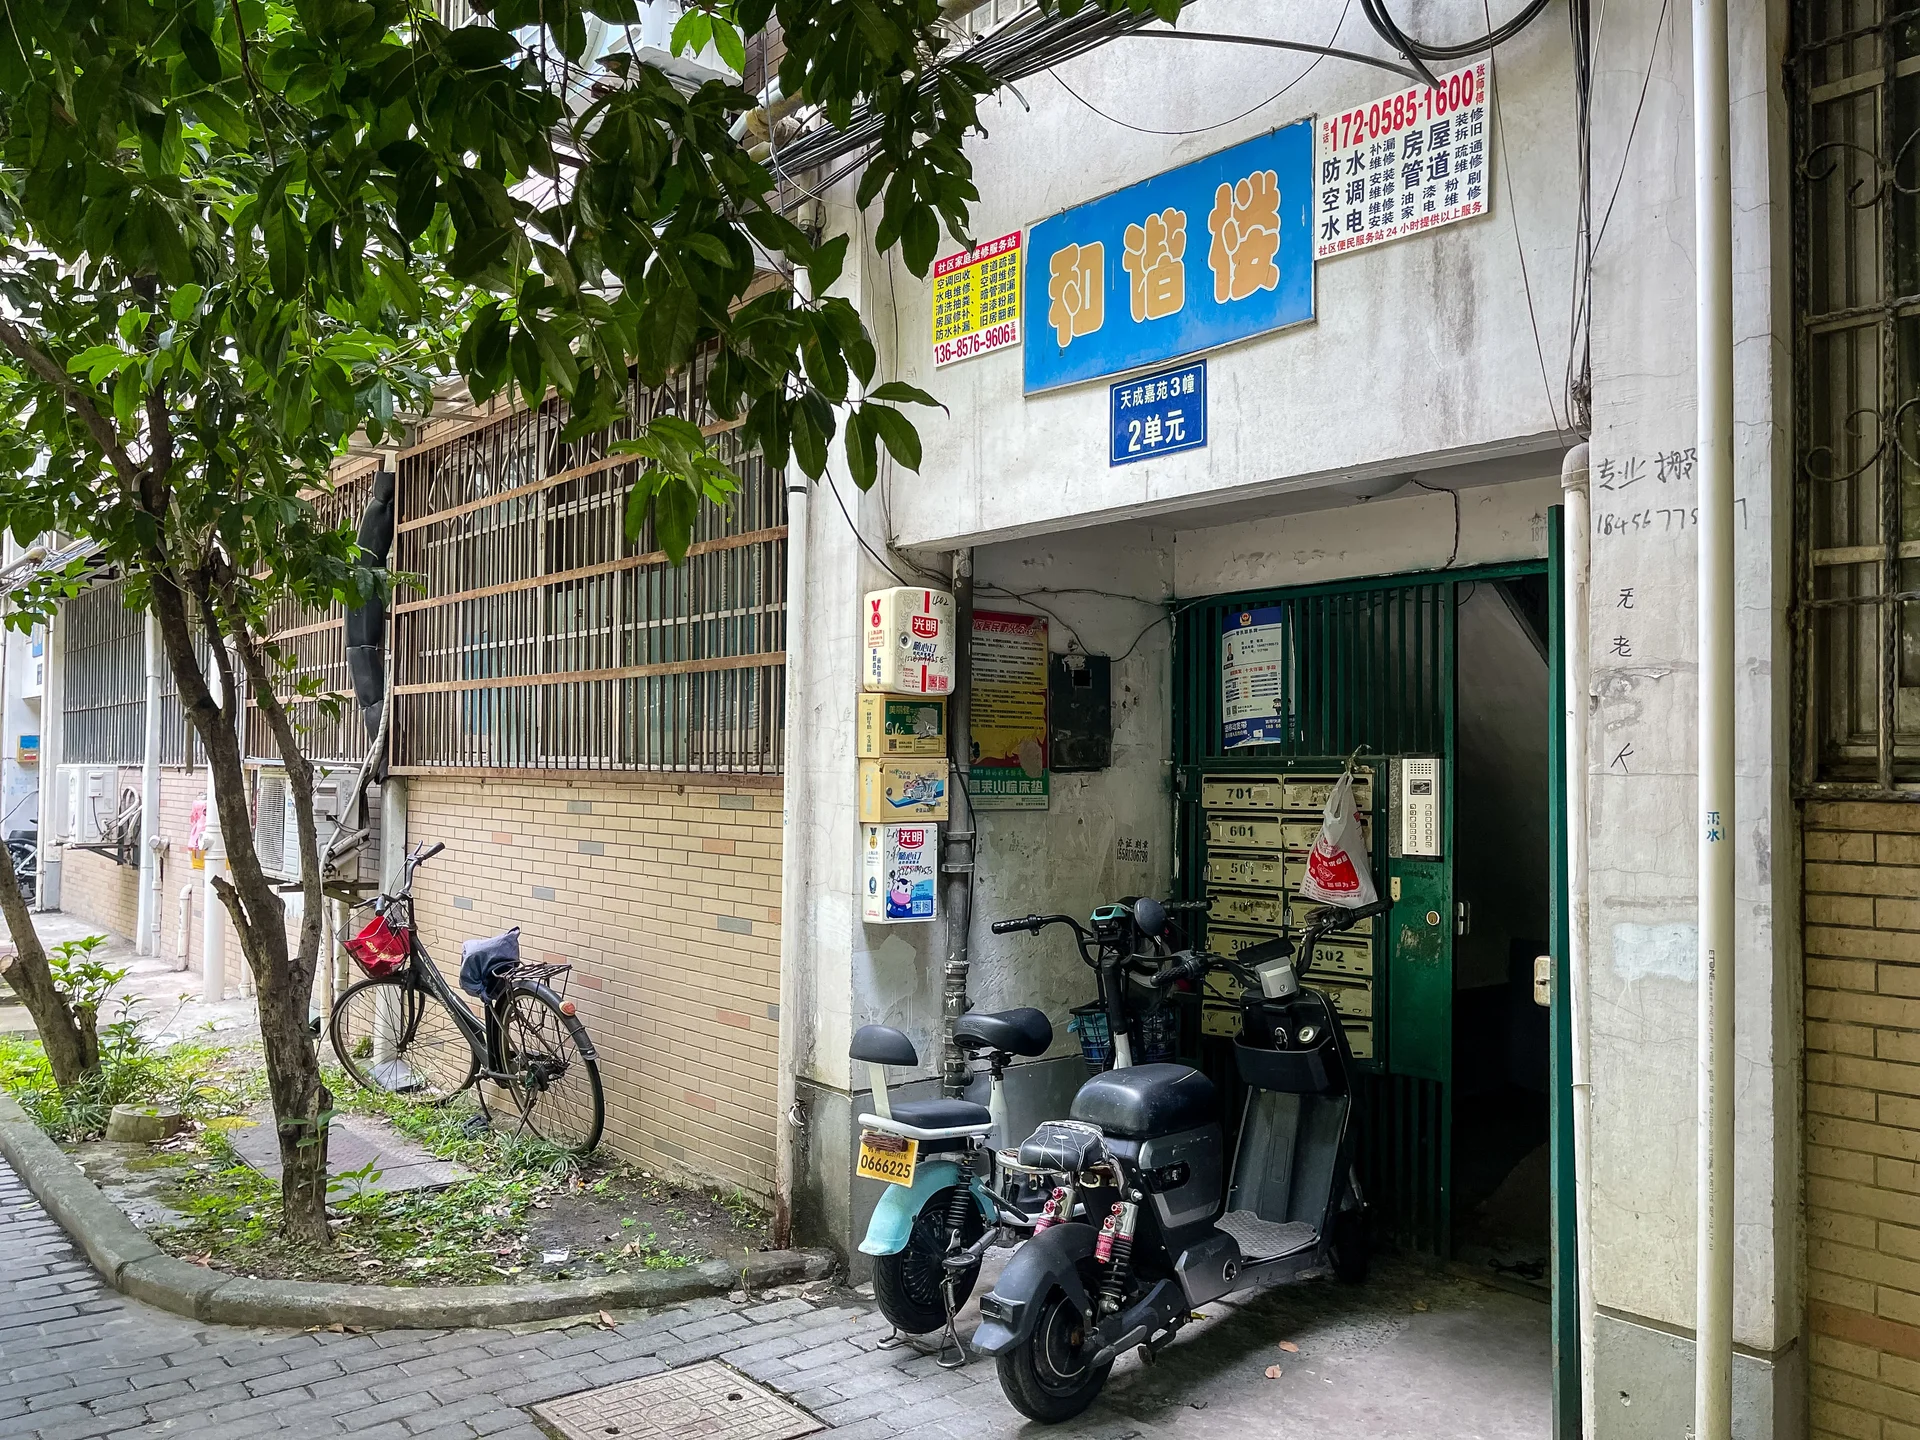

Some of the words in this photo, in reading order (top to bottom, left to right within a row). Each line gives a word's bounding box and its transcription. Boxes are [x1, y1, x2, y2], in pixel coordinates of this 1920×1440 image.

[1330, 69, 1474, 152] 172-0585-1600
[1455, 106, 1484, 128] 装修
[1401, 119, 1451, 161] 房屋
[1454, 122, 1483, 142] 拆旧
[1369, 137, 1396, 156] 补漏
[1454, 140, 1484, 160] 疏通
[1322, 150, 1366, 186] 防水
[1369, 152, 1396, 170] 维修
[1401, 150, 1451, 190] 管道
[1454, 154, 1484, 174] 维修
[1368, 168, 1396, 187] 安装
[1321, 178, 1366, 214] 空调
[1368, 182, 1396, 200] 维修
[1368, 197, 1395, 217] 维修
[1320, 208, 1365, 242] 水电
[1368, 211, 1395, 230] 安装
[938, 236, 1017, 274] 社区家庭维修服务站
[980, 252, 1017, 276] 管道疏通
[1048, 169, 1281, 348] 和谐楼
[980, 266, 1016, 289] 空调维修
[934, 324, 1010, 364] 136-8576-9606
[1120, 374, 1195, 410] 天成嘉苑3幢
[1128, 409, 1186, 452] 2单元
[914, 617, 937, 632] 光明
[1226, 787, 1253, 800] 701
[900, 831, 923, 842] 光明
[1230, 826, 1254, 838] 601
[1316, 950, 1344, 963] 302
[860, 1154, 912, 1178] 0666225
